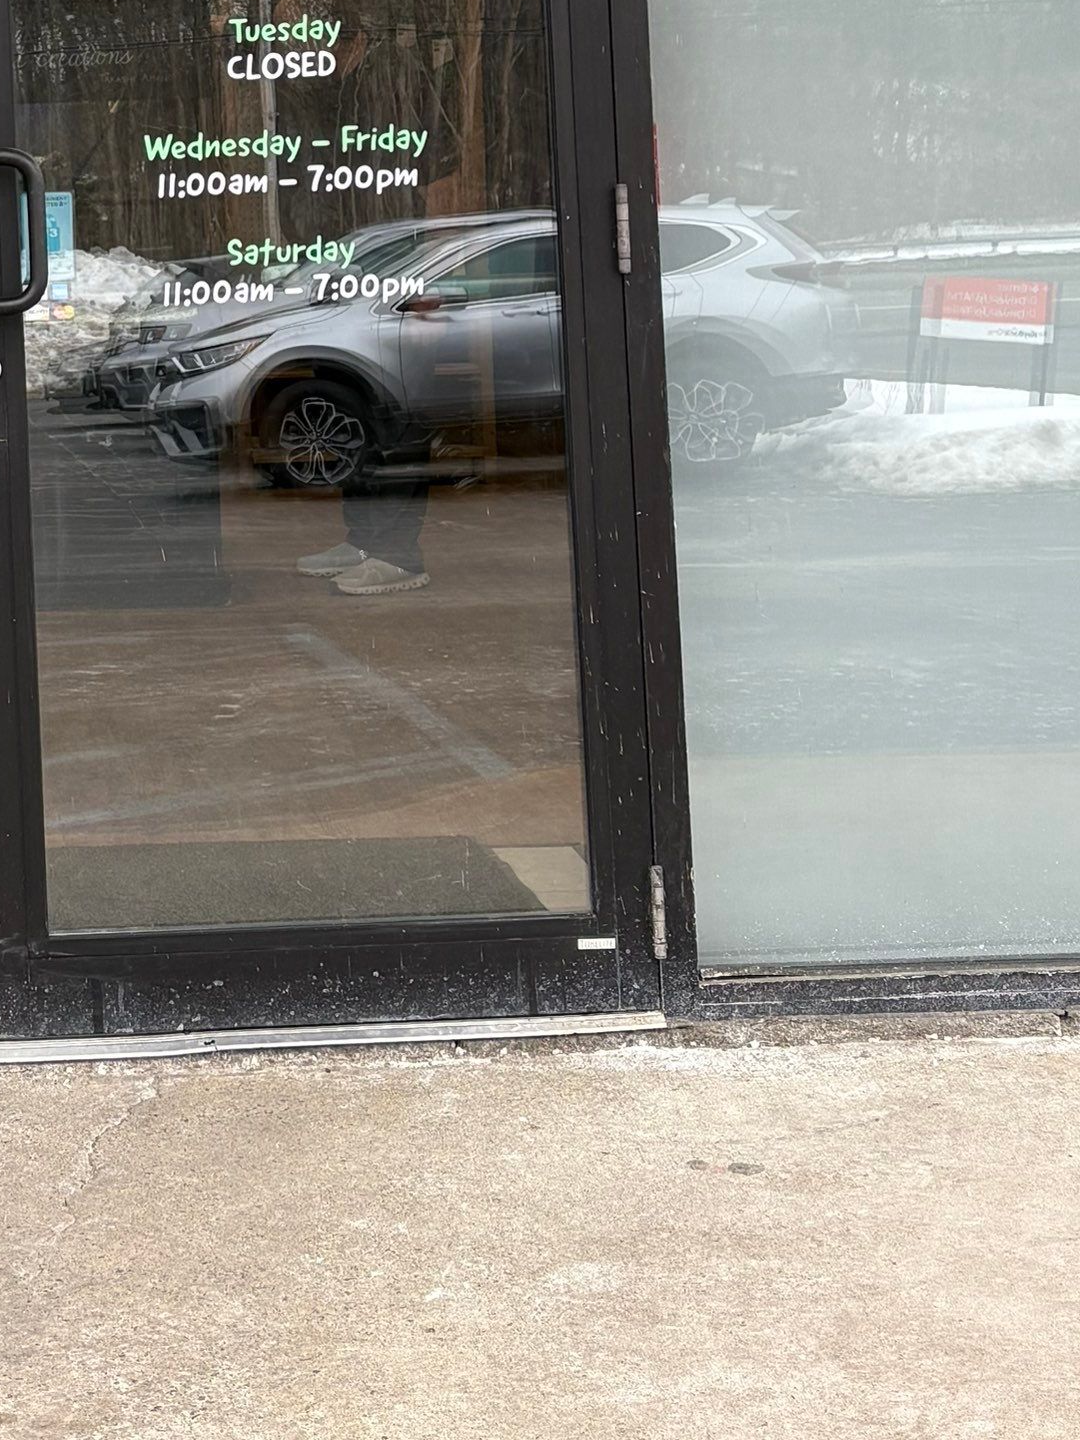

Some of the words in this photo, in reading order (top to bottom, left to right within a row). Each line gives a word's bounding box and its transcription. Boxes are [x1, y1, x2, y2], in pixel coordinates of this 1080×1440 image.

[228, 16, 341, 47] Tuesday
[226, 49, 337, 81] CLOSED
[143, 133, 302, 164] Wednesday
[340, 124, 428, 158] Friday
[157, 170, 269, 199] 11:00am
[306, 164, 419, 195] 7:00pm
[226, 238, 356, 271] Saturday
[162, 279, 275, 308] 11:00am
[312, 272, 425, 304] 7:00pm
